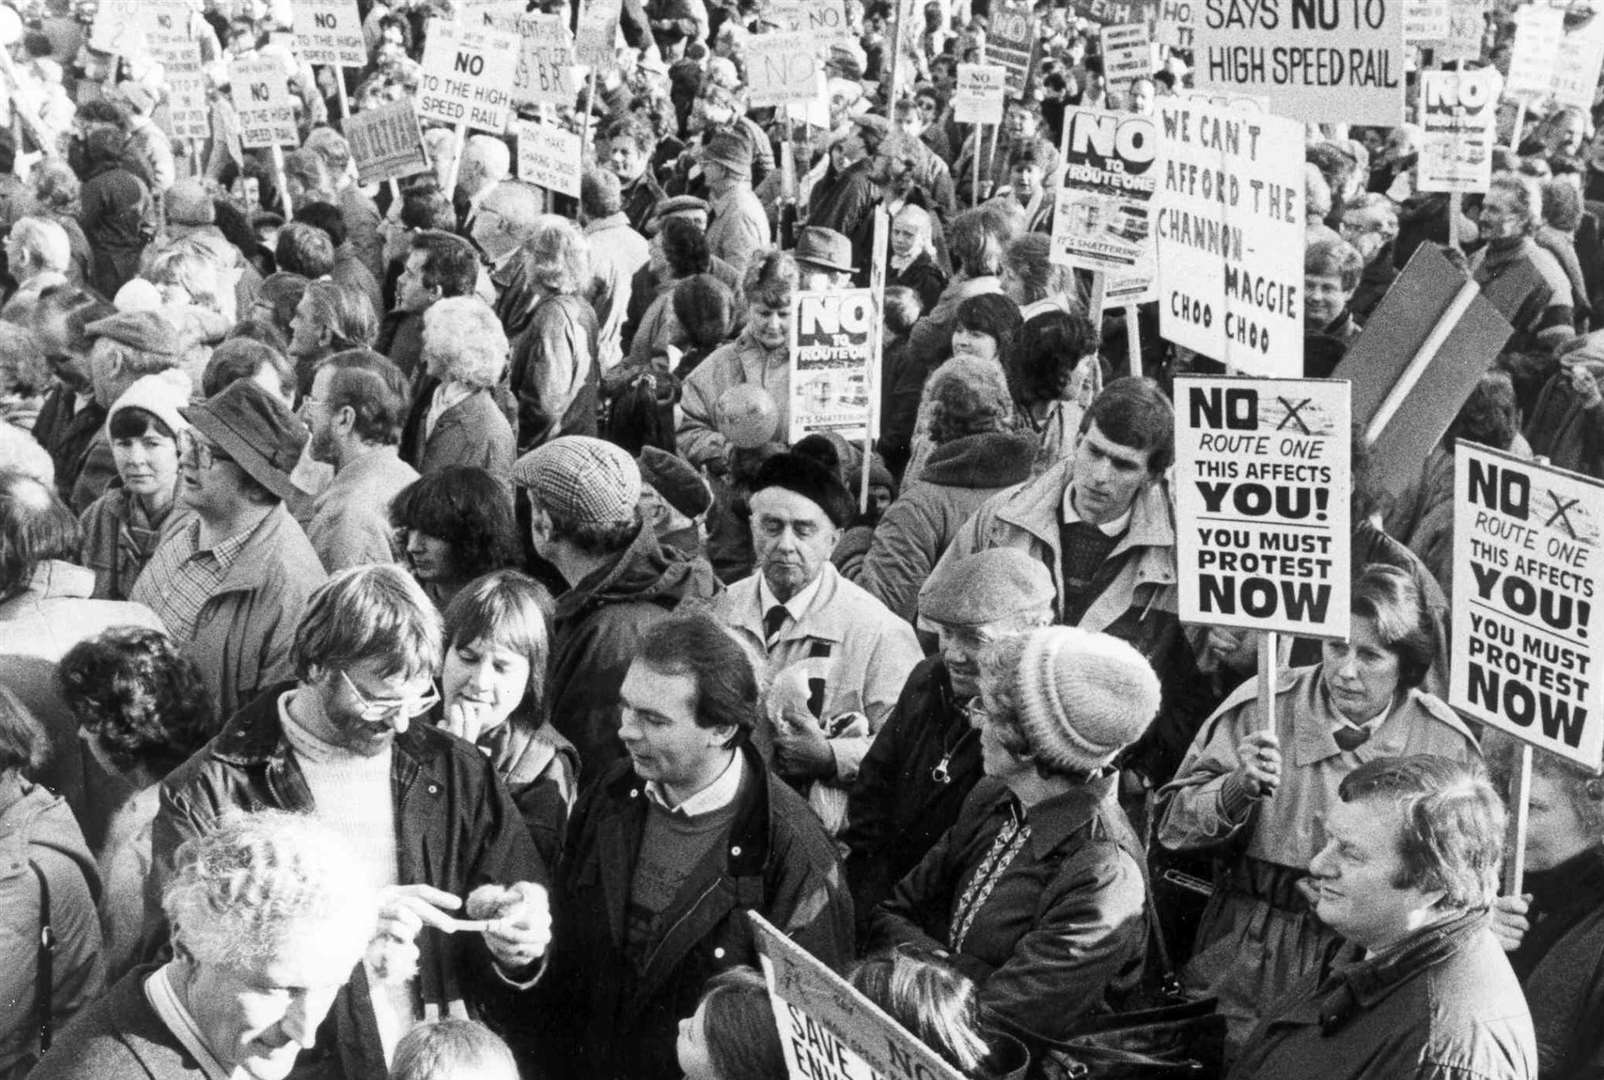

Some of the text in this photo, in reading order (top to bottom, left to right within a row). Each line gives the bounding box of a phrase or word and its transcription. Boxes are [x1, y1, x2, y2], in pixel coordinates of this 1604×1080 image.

[314, 12, 337, 29] NO
[809, 8, 839, 29] NO
[1206, 0, 1279, 30] SAYS
[1292, 0, 1339, 31] NO
[454, 51, 484, 76] NO
[1208, 46, 1398, 88] HIGH SPEED RAIL
[250, 82, 270, 102] NO
[424, 74, 508, 105] TO THE HIGH
[1427, 76, 1488, 108] NO
[422, 95, 499, 128] SPEED RAIL
[1069, 111, 1156, 166] NO
[1162, 108, 1261, 162] WE CAN'T
[1069, 165, 1122, 187] ROUTE
[1105, 157, 1124, 171] TO
[1166, 159, 1297, 224] AFFORD THE
[1224, 262, 1297, 320] MAGGIE
[800, 294, 870, 334] NO
[1171, 290, 1269, 354] CHOO CHOO
[832, 334, 849, 346] TO
[1189, 387, 1258, 431] NO
[1199, 433, 1325, 460] ROUTE ONE
[1195, 460, 1332, 483] THIS AFFECTS
[1468, 457, 1531, 522] NO
[1195, 481, 1330, 522] YOU!
[1198, 528, 1332, 554] YOU MUST
[1475, 511, 1589, 568] ROUTE ONE
[1198, 549, 1332, 579] PROTEST
[1470, 538, 1594, 598] THIS AFFECTS
[1198, 573, 1332, 624] NOW
[1470, 560, 1592, 639] YOU!
[1470, 611, 1591, 675] YOU MUST
[1469, 634, 1590, 703] PROTEST
[1468, 660, 1588, 750] NOW
[787, 1002, 853, 1080] SAVE
